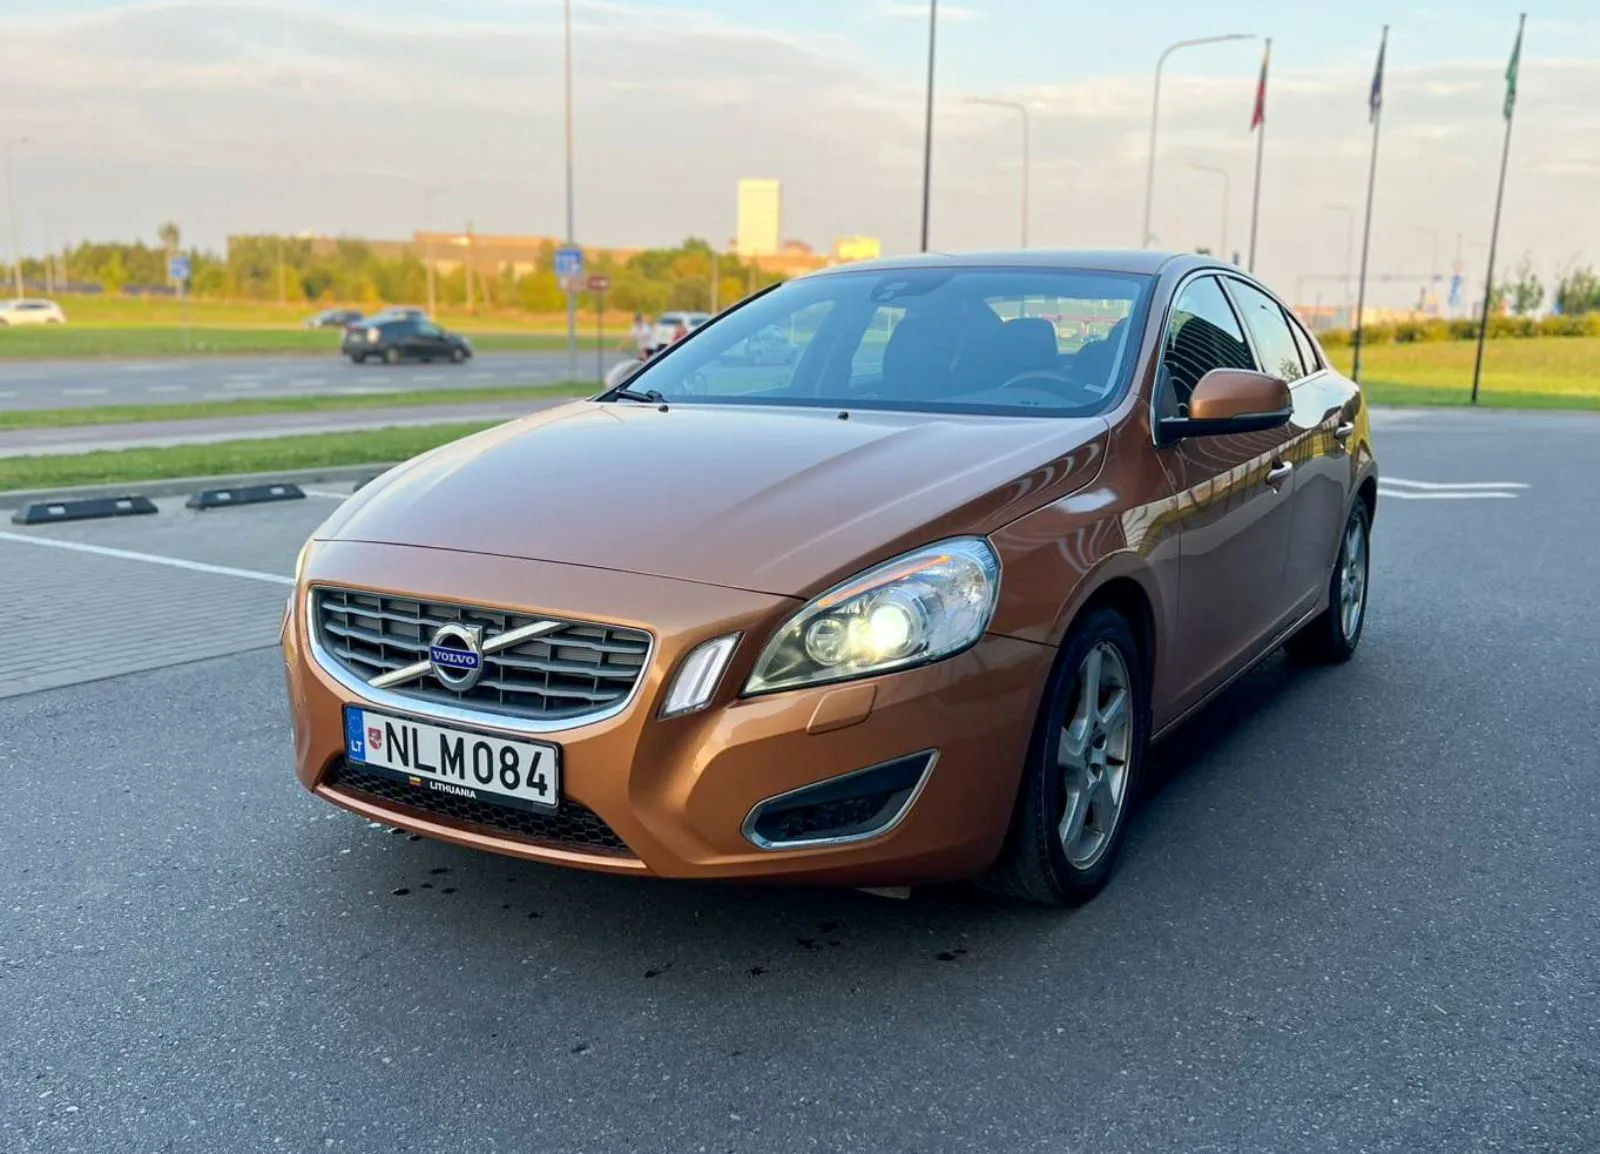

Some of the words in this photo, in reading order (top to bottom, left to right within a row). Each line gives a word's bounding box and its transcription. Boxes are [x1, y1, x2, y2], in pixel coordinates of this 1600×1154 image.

[432, 650, 476, 665] VOLVO
[351, 740, 362, 753] LT
[385, 721, 548, 796] NLM084
[429, 780, 477, 799] LITHUANIA
